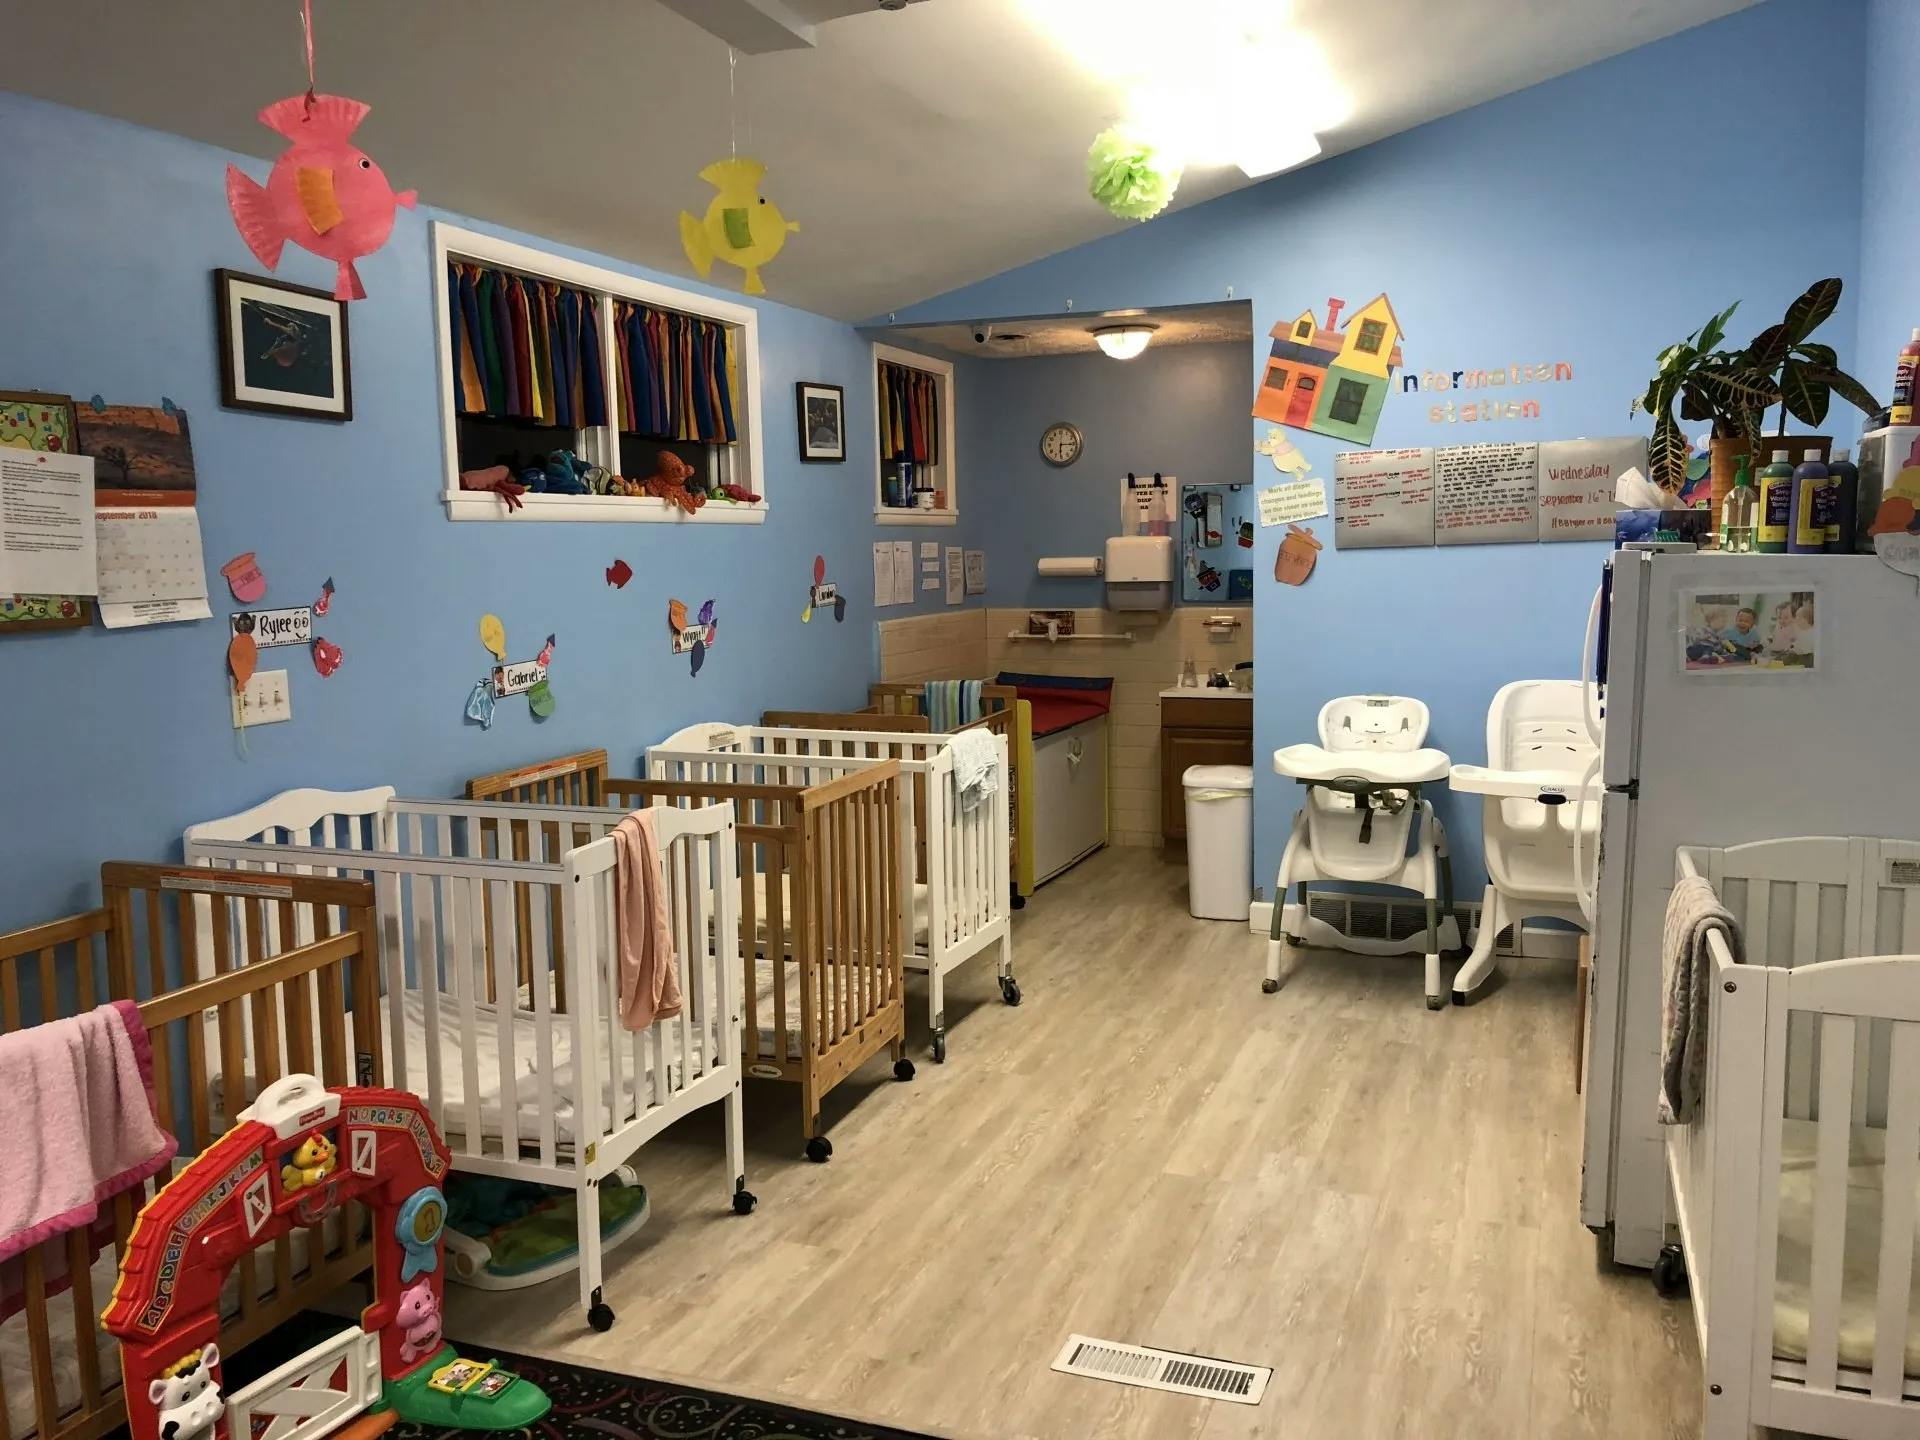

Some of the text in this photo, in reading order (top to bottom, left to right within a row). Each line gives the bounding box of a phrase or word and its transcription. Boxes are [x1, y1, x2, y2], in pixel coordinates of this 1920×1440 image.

[1429, 400, 1540, 424] station
[1548, 464, 1610, 480] Wednesday
[507, 667, 539, 687] Gabriel
